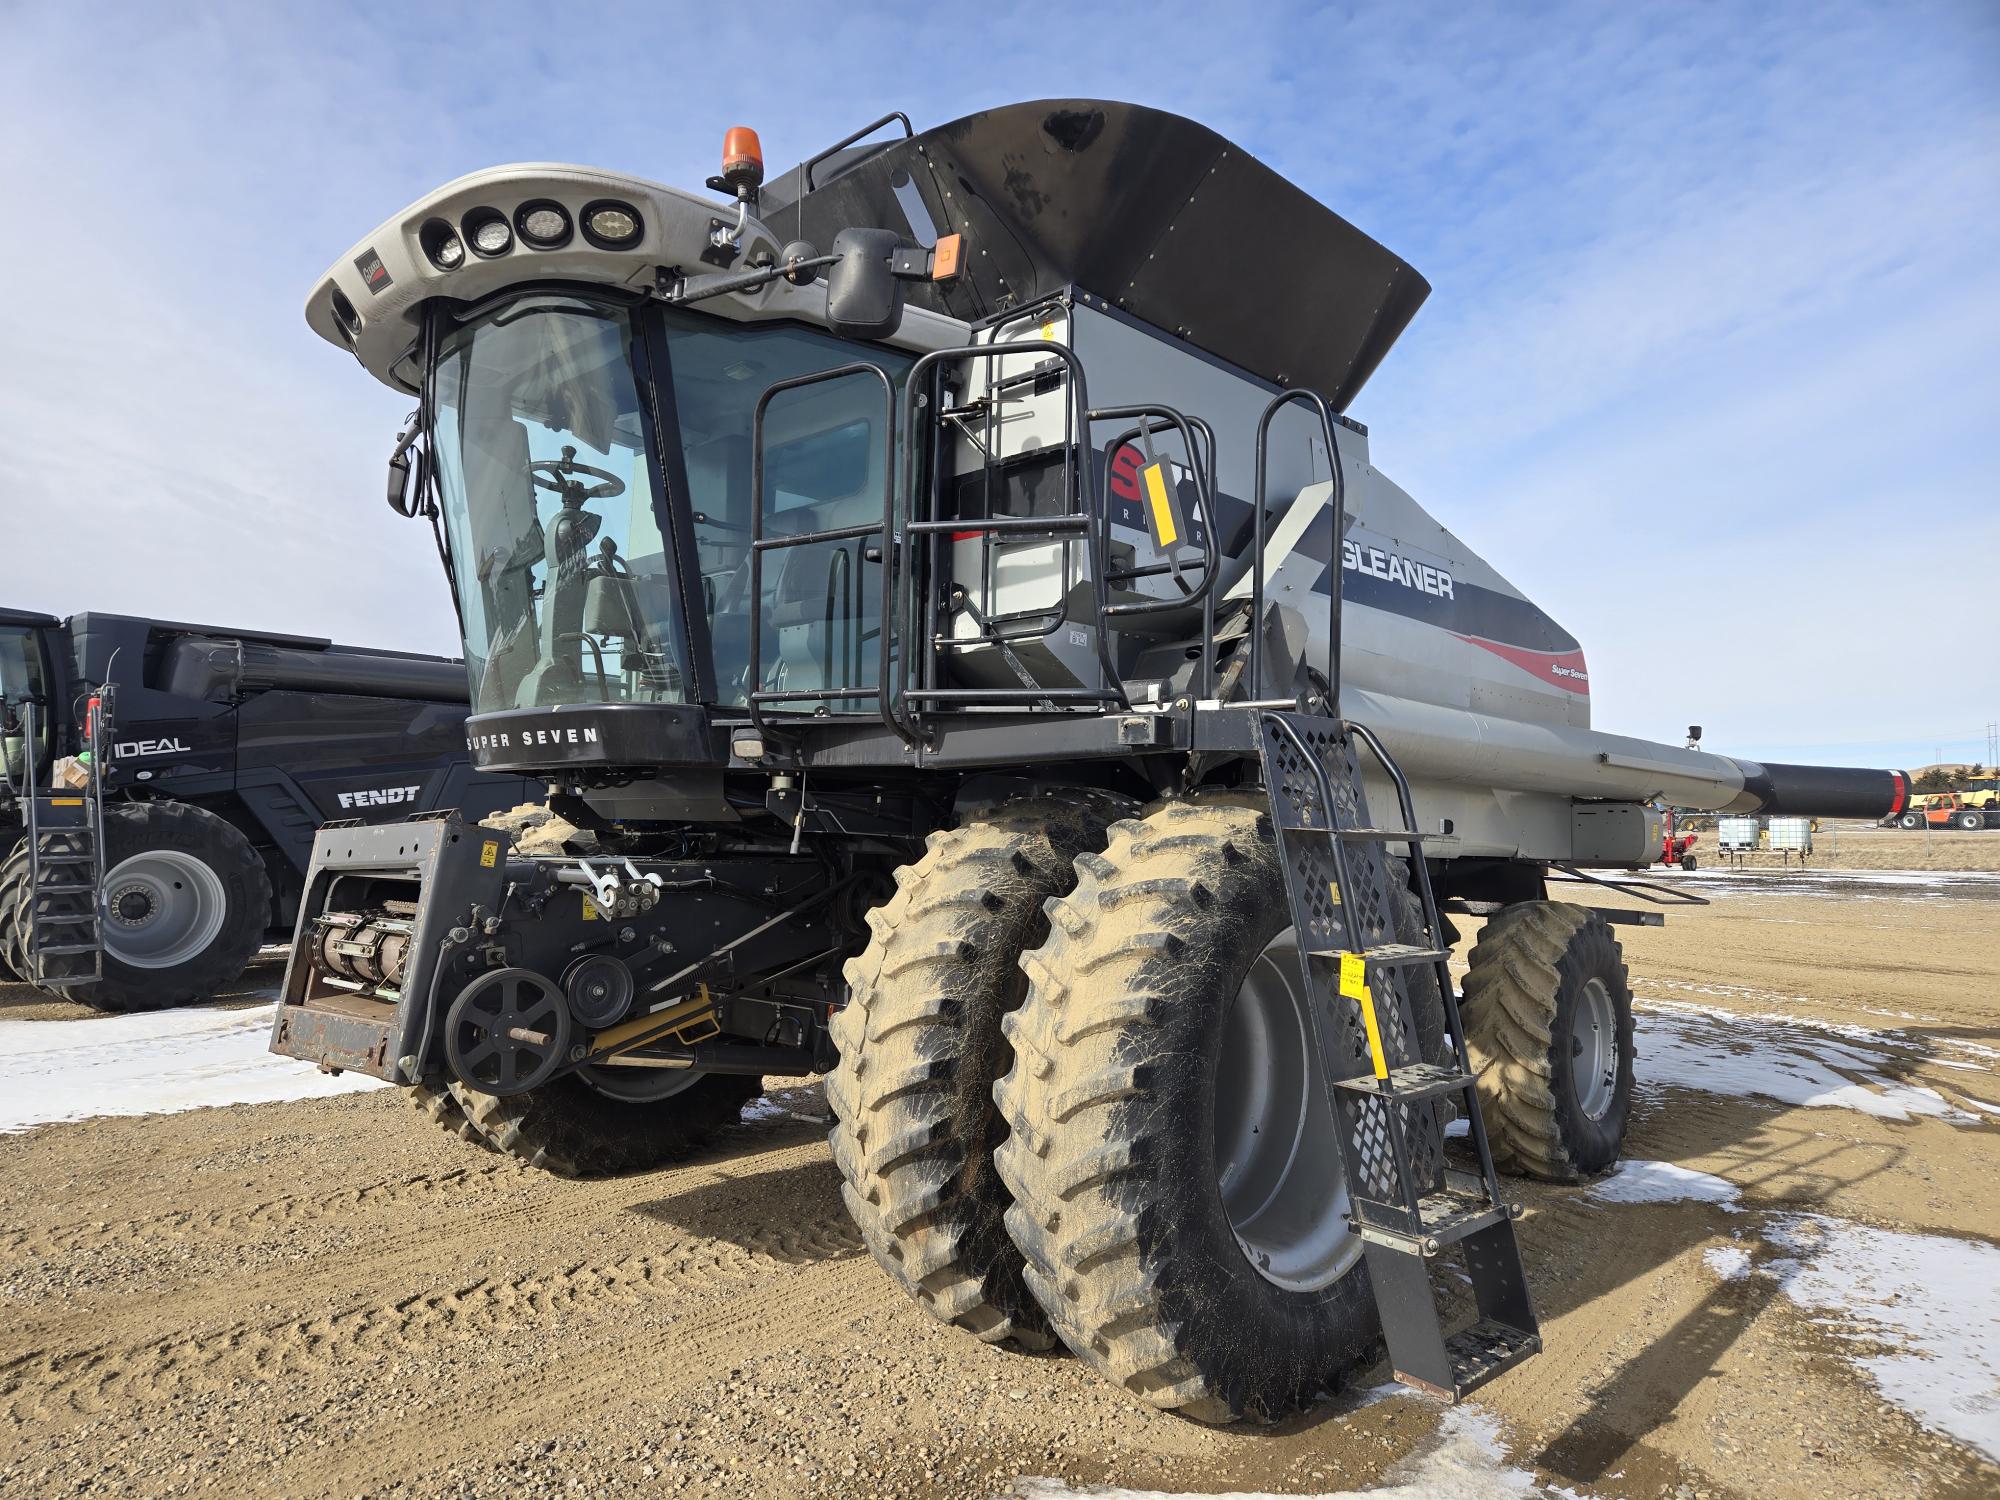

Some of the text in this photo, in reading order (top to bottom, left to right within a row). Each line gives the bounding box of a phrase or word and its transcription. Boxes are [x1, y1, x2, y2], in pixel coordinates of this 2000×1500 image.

[1343, 539, 1455, 600] GLEANER
[1552, 664, 1588, 681] Super Seven
[114, 737, 191, 759] IDEAL
[466, 728, 598, 751] SUPER SEVEN
[337, 785, 420, 809] FENDT
